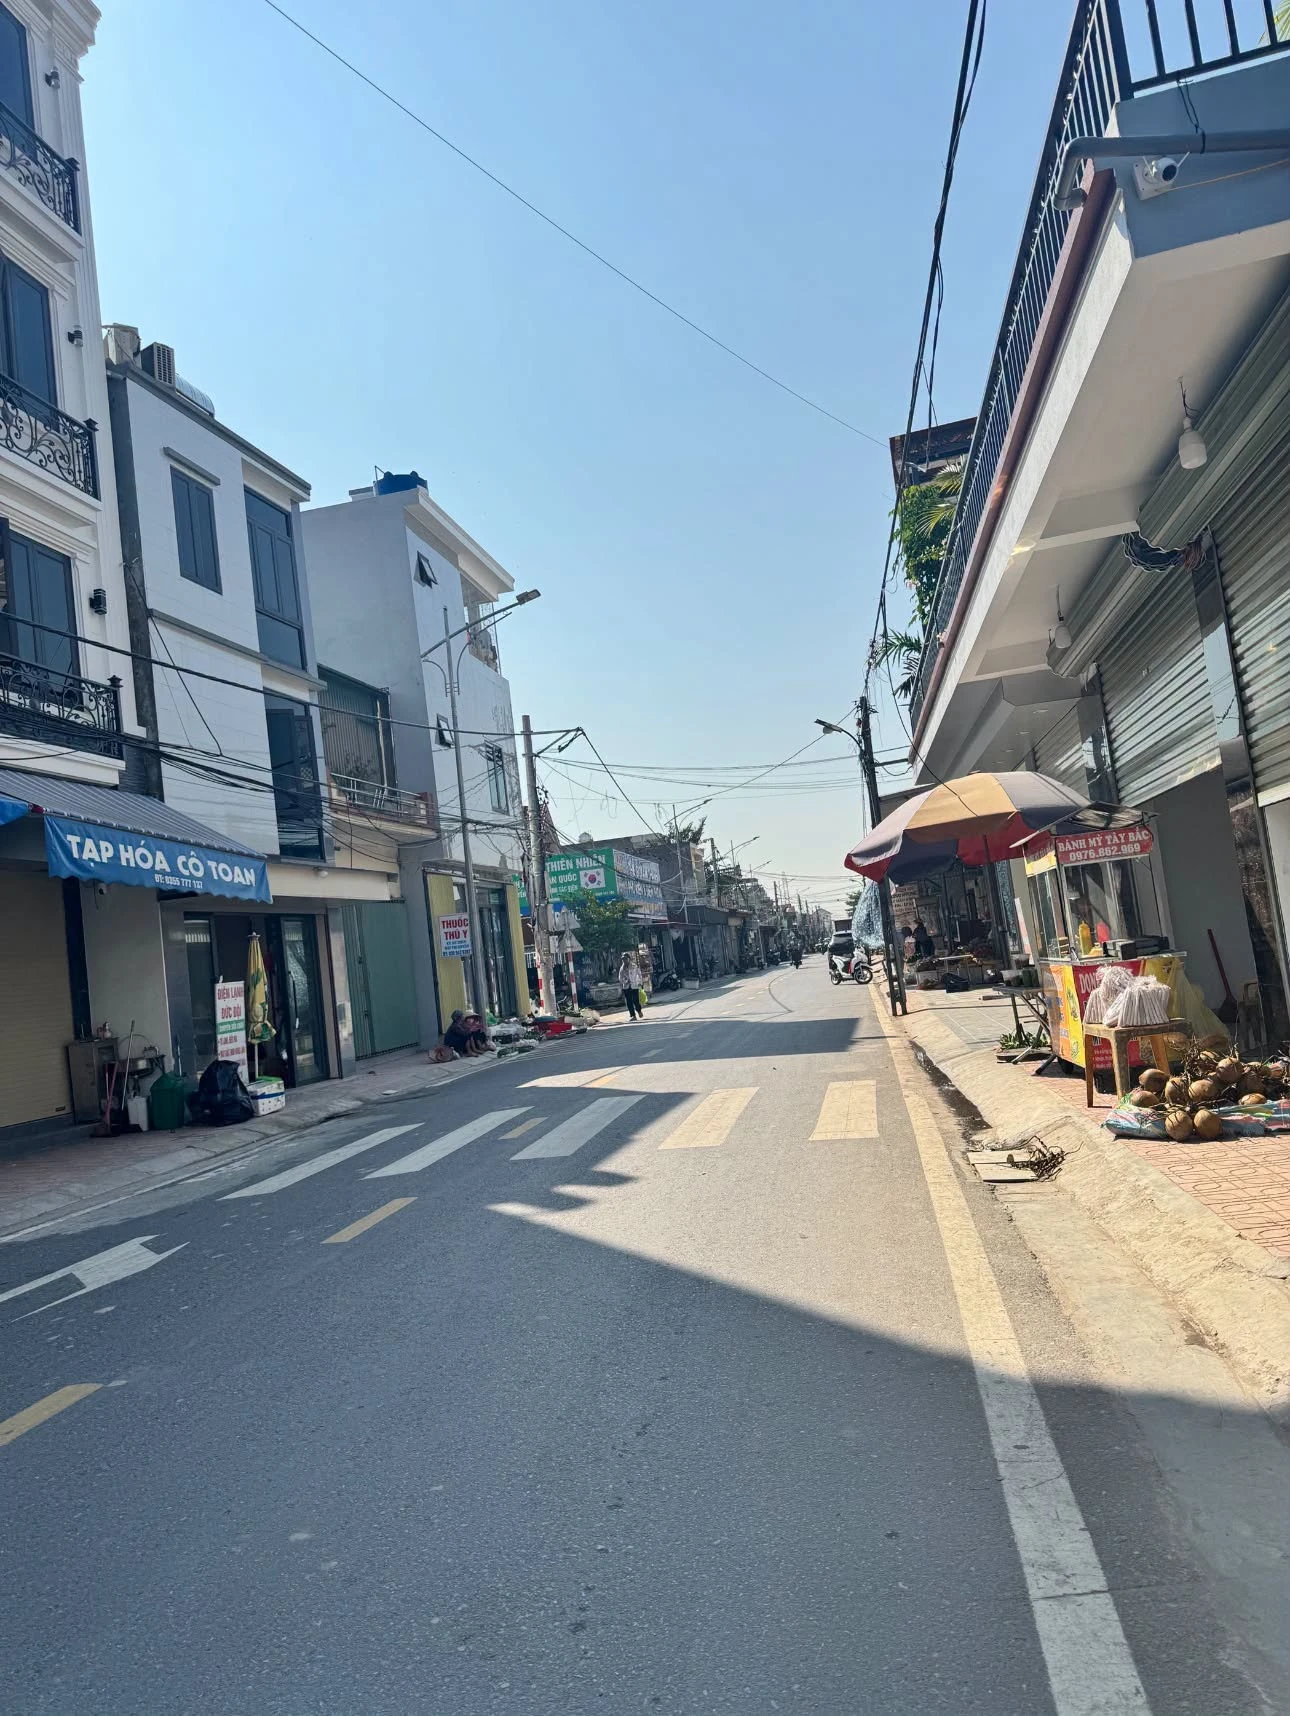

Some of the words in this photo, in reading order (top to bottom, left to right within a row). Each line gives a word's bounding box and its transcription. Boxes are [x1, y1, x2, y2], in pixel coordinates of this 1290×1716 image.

[1058, 839, 1087, 852] BÁNH
[1105, 832, 1125, 845] TÂY
[1129, 827, 1149, 842] BẮC
[67, 834, 114, 868] TẠP
[119, 840, 171, 872] HÓA
[177, 851, 204, 877] CÔ
[208, 861, 256, 887] TOAN
[1069, 843, 1140, 861] 0976.862.969
[545, 858, 573, 872] THIÊN
[576, 854, 606, 869] NHIÊN
[559, 872, 577, 883] QUỐC
[441, 916, 469, 929] THUỐC
[462, 930, 468, 939] Y
[218, 986, 230, 1002] ĐIỆN
[231, 985, 244, 1001] LẠNH
